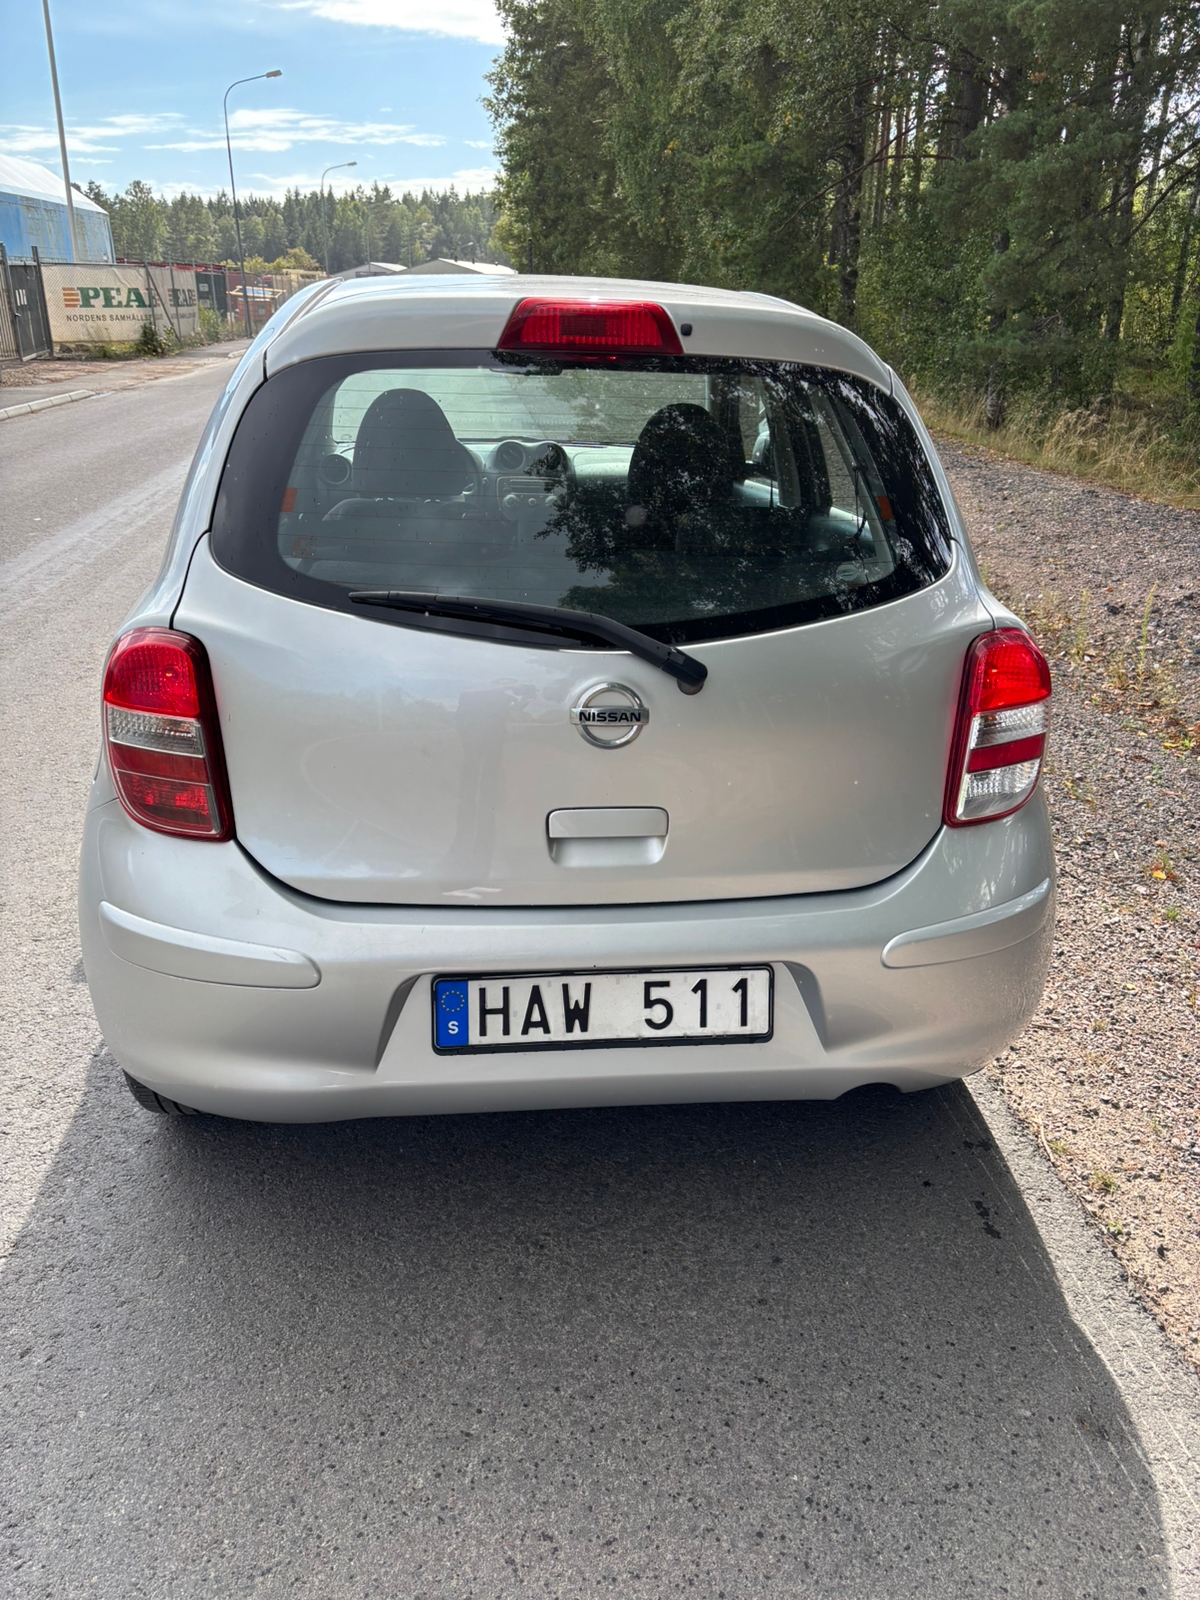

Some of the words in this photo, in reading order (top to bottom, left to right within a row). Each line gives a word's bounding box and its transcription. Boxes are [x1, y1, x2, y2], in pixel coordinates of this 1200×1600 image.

[66, 314, 107, 322] NORDENS
[578, 711, 642, 723] NISSAN
[478, 982, 592, 1037] HAW
[643, 977, 749, 1031] 511
[447, 1020, 460, 1036] S
